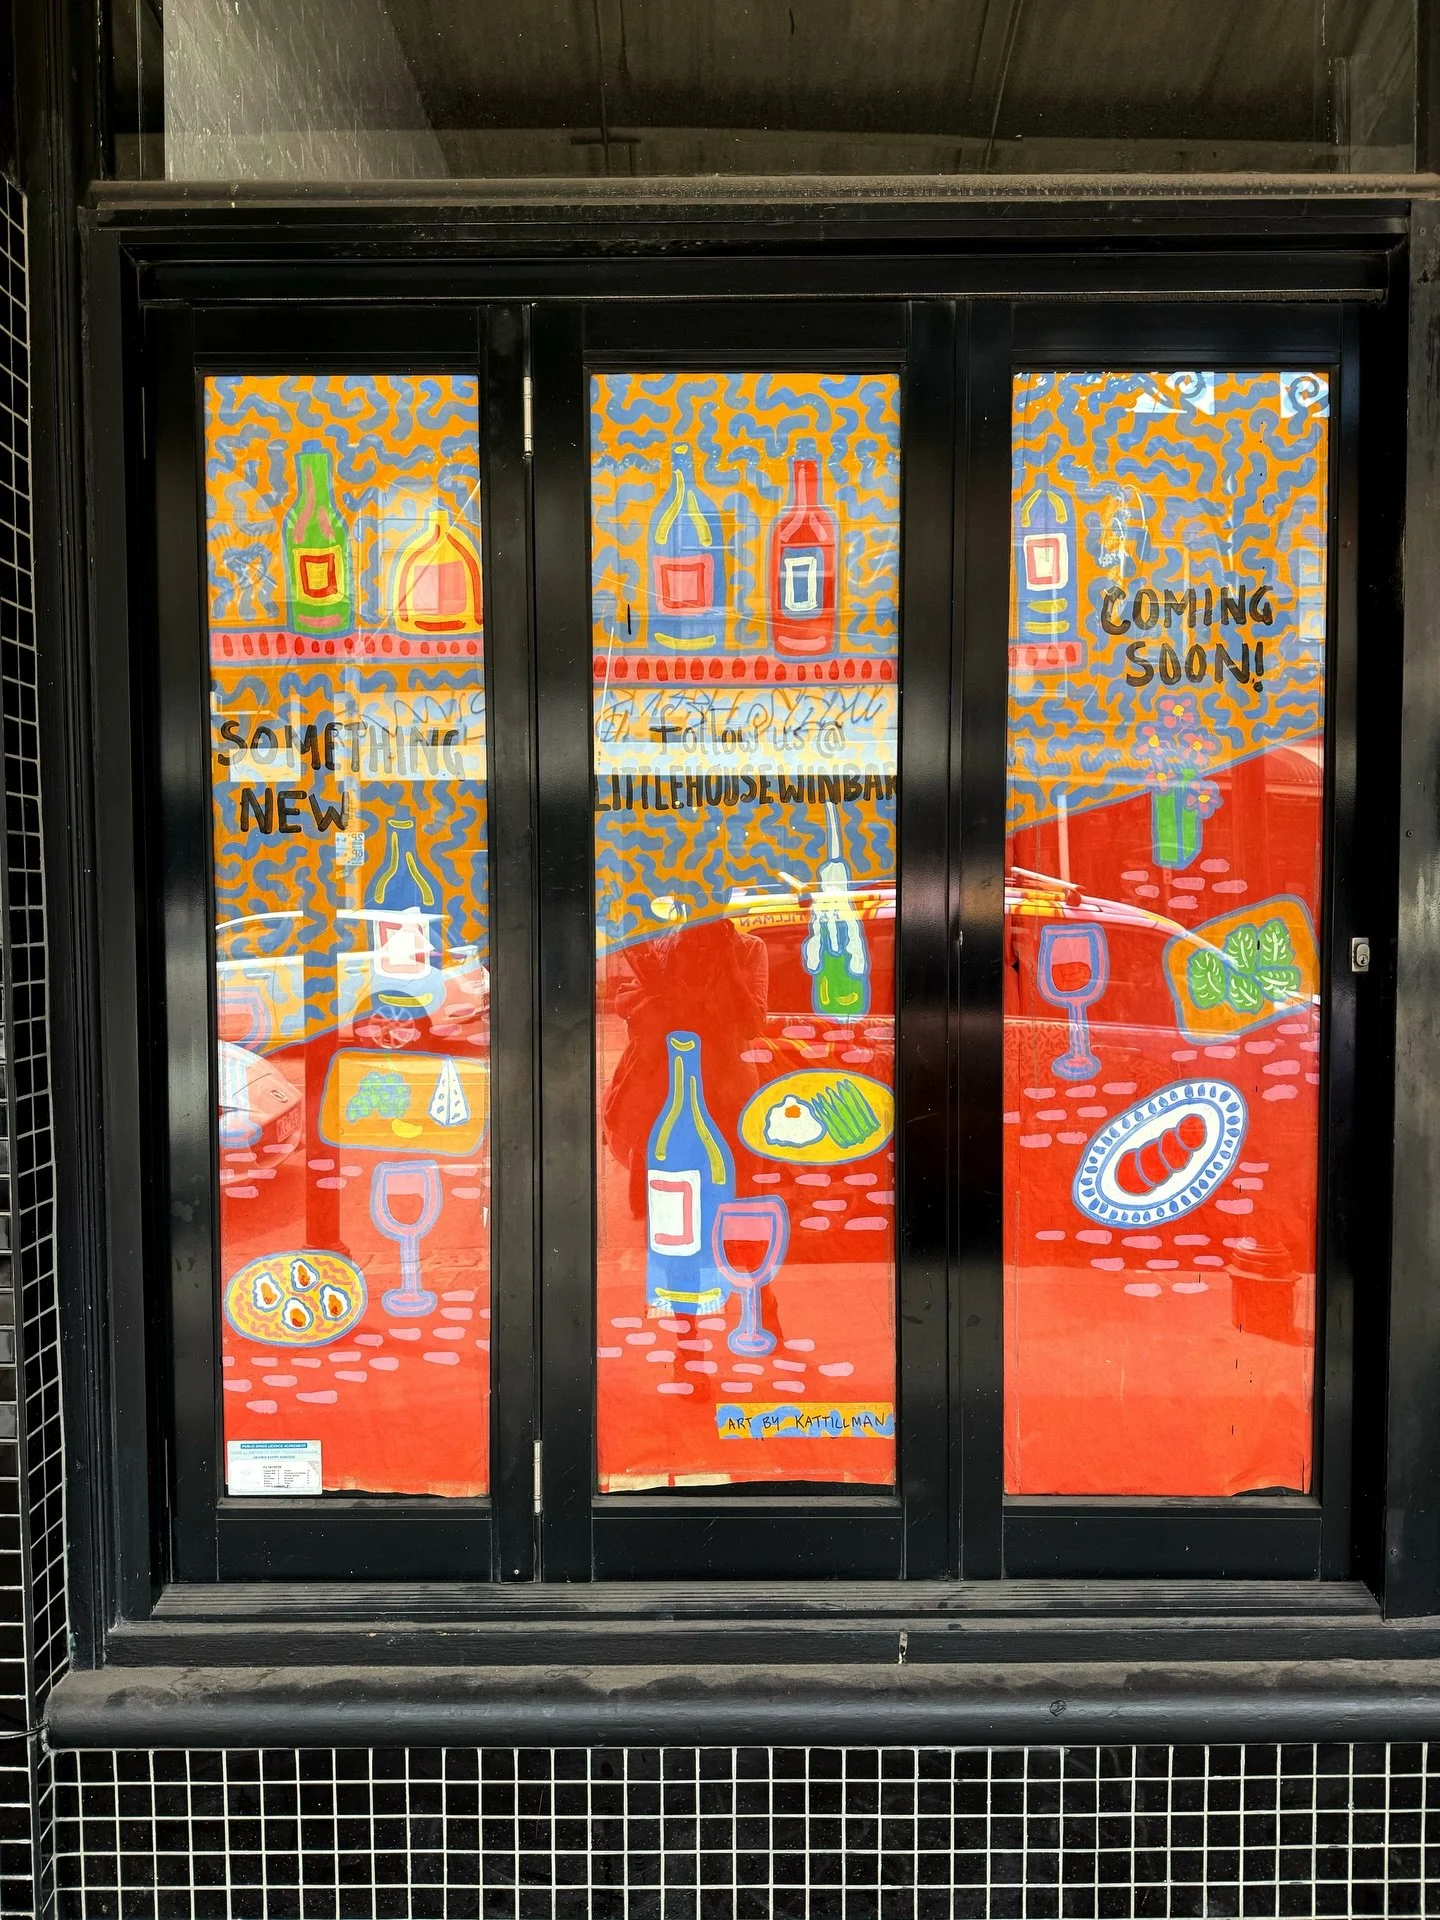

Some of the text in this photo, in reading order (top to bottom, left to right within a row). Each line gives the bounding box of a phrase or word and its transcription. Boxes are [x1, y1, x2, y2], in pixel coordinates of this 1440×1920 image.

[1101, 584, 1273, 635] COMING
[1126, 641, 1264, 693] SOON!
[217, 720, 466, 781] SOMETHING
[240, 787, 349, 835] NEW
[728, 1417, 753, 1430] ART
[762, 1415, 780, 1431] BY
